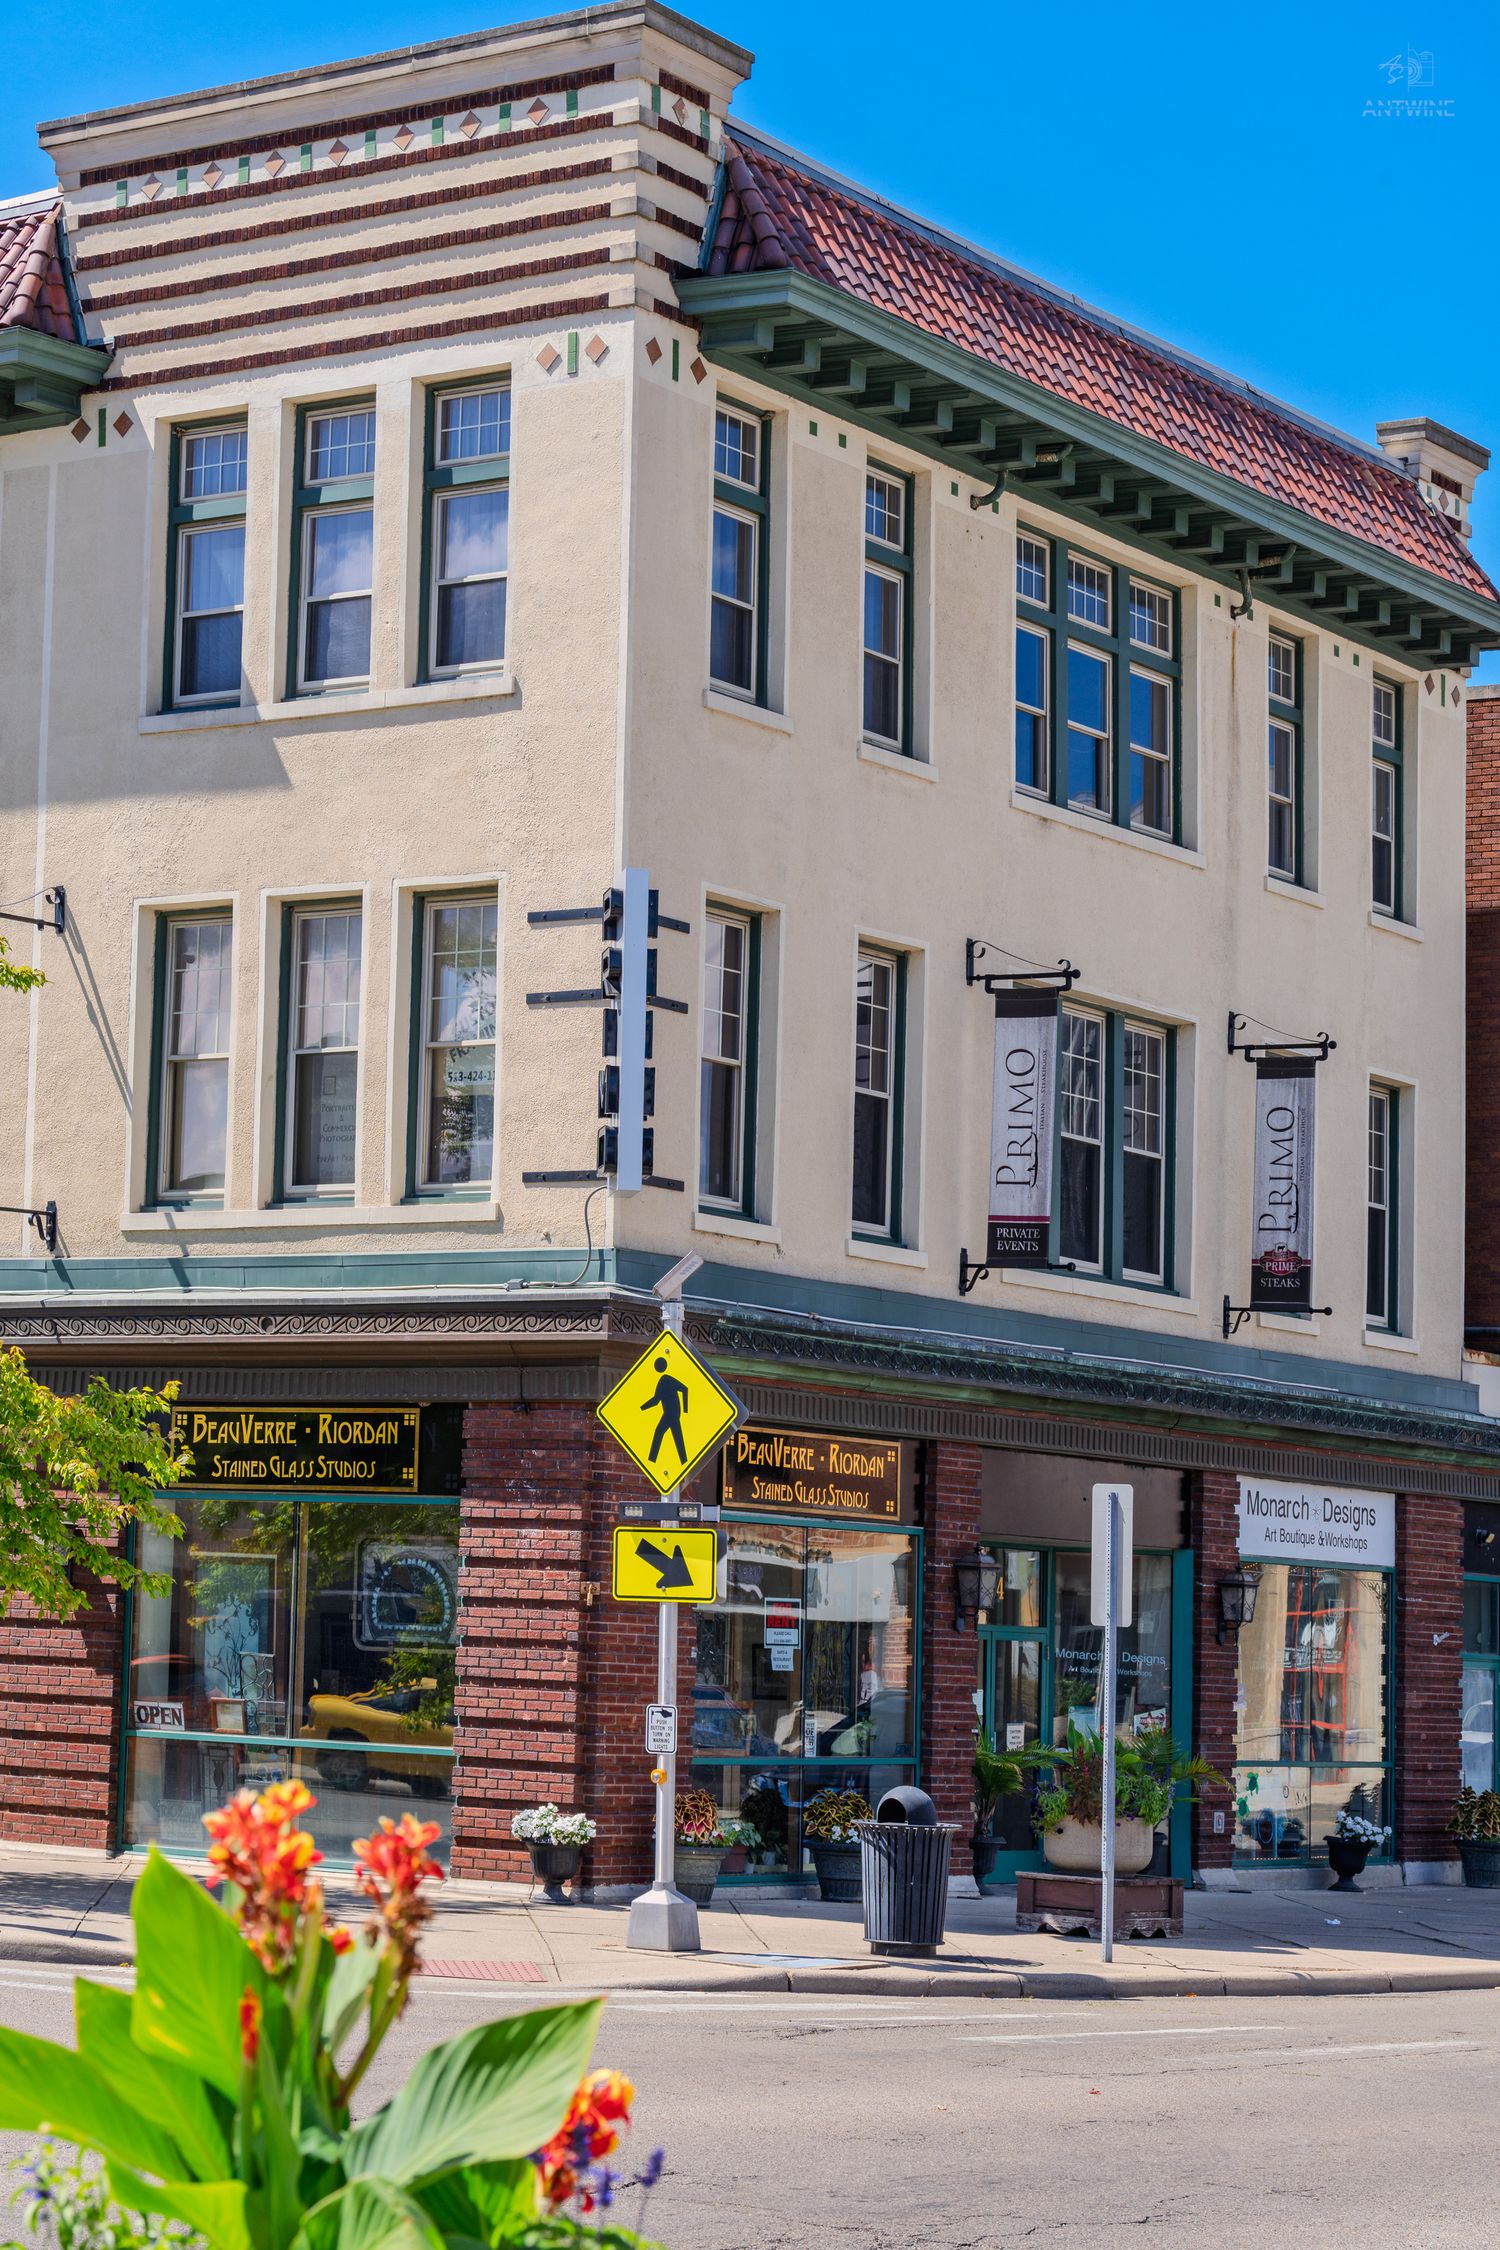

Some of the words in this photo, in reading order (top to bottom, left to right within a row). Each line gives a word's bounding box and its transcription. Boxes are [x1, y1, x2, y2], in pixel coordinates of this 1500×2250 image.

[996, 1048, 1038, 1187] PRIMO
[1257, 1106, 1299, 1234] PRIMO
[996, 1227, 1040, 1239] PRIVATE
[996, 1240, 1039, 1252] EVENTS
[1265, 1261, 1297, 1271] PRIME
[1260, 1278, 1300, 1288] STEAKS
[1246, 1489, 1310, 1521] Monarch
[1323, 1497, 1377, 1532] Designs
[1264, 1527, 1277, 1543] Art
[1279, 1528, 1315, 1548] Boutique
[767, 1615, 797, 1628] RENT
[1055, 1647, 1104, 1661] Monarch
[1122, 1652, 1166, 1666] Designs
[136, 1705, 183, 1726] OPEN
